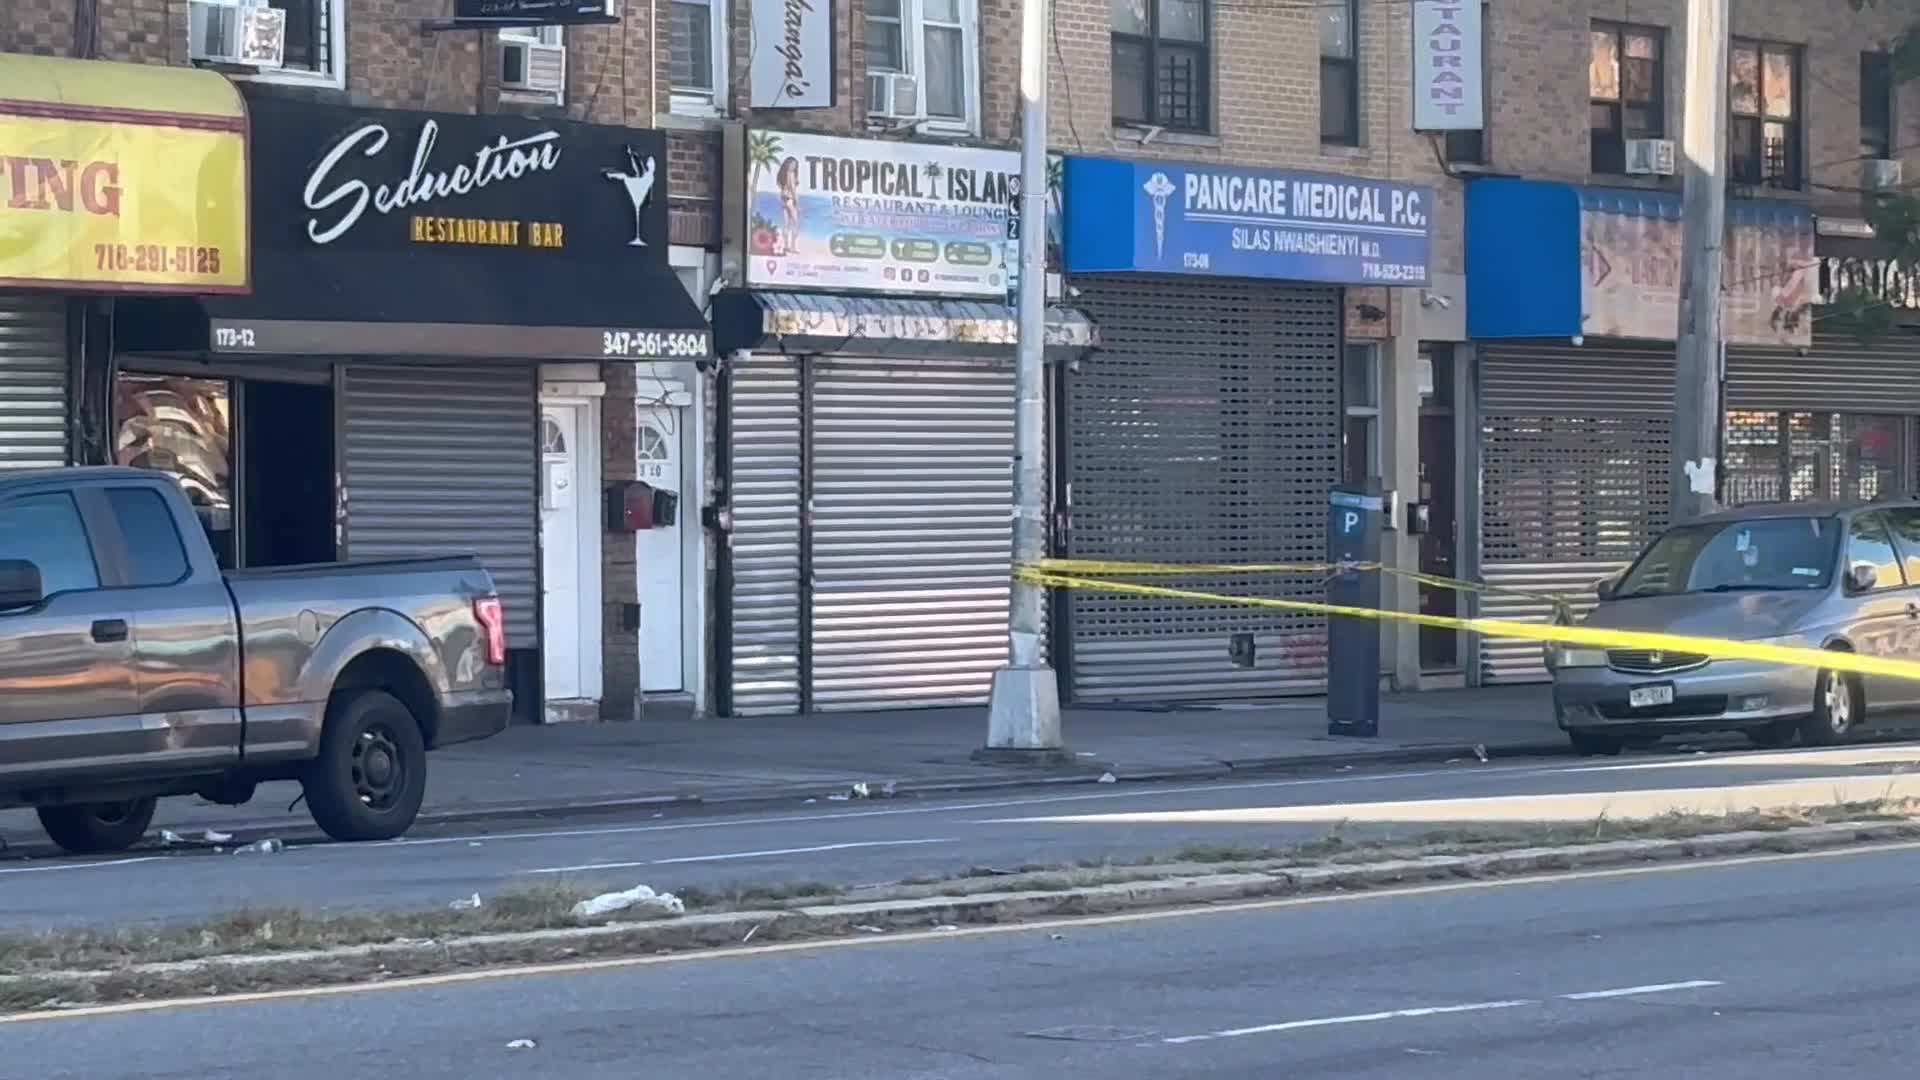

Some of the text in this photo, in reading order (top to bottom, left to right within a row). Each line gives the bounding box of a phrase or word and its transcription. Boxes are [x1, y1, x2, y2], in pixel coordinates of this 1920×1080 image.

[1430, 0, 1464, 115] TAURANT
[0, 156, 123, 216] ING
[303, 119, 561, 244] Seduction
[805, 156, 1010, 205] TROPICAL ISLAN
[832, 195, 936, 214] RESTAURANT
[1184, 173, 1427, 226] PANCARE MEDICAL P.C.
[413, 216, 564, 247] RESTAURANT BAR
[1232, 227, 1271, 250] SILAS
[1274, 230, 1359, 256] NWAISHIENYI
[216, 327, 256, 347] 173-12
[603, 331, 708, 357] 347-561-5604
[1344, 511, 1359, 533] P
